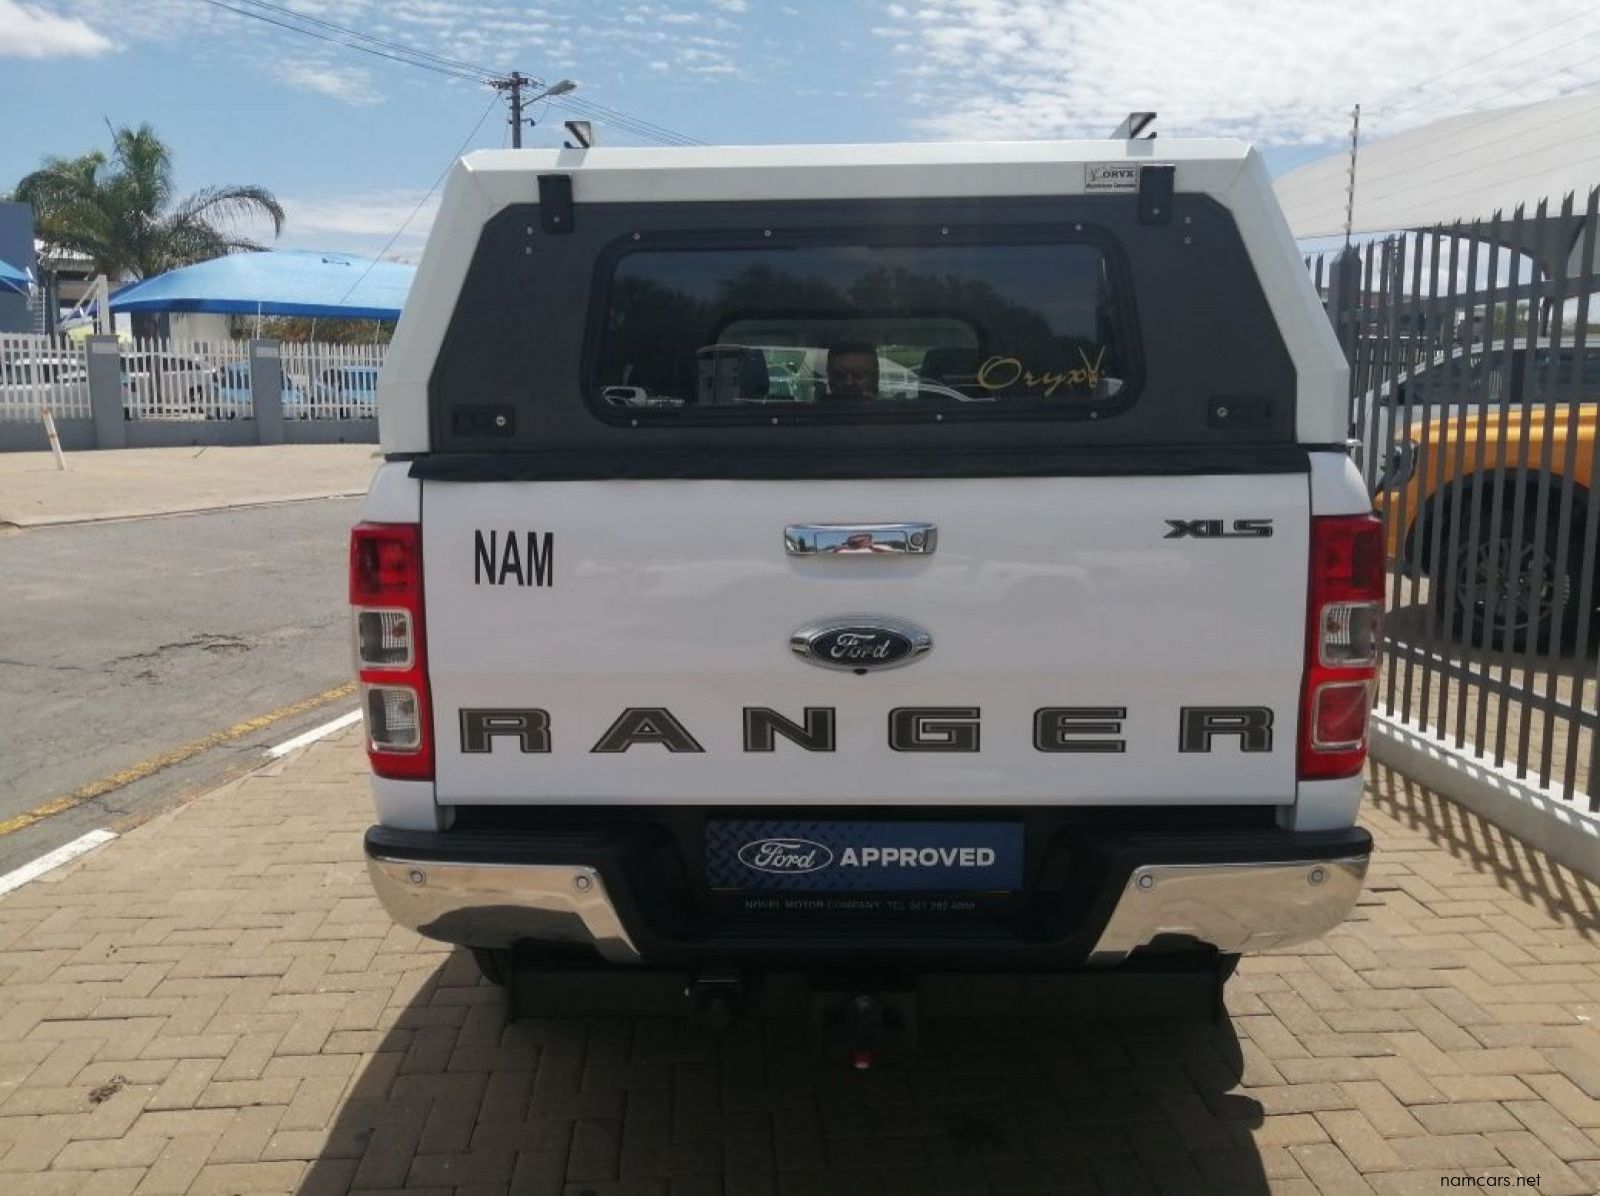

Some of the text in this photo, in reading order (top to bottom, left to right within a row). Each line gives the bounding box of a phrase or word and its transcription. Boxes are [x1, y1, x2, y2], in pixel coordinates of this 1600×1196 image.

[1163, 519, 1273, 538] XLS
[475, 530, 553, 587] NAM
[831, 633, 890, 658] Ford
[459, 707, 1274, 754] RANGER
[754, 841, 816, 868] Ford
[840, 847, 995, 867] APPROVED
[785, 900, 824, 909] MOTOR
[827, 900, 880, 909] COMPANY
